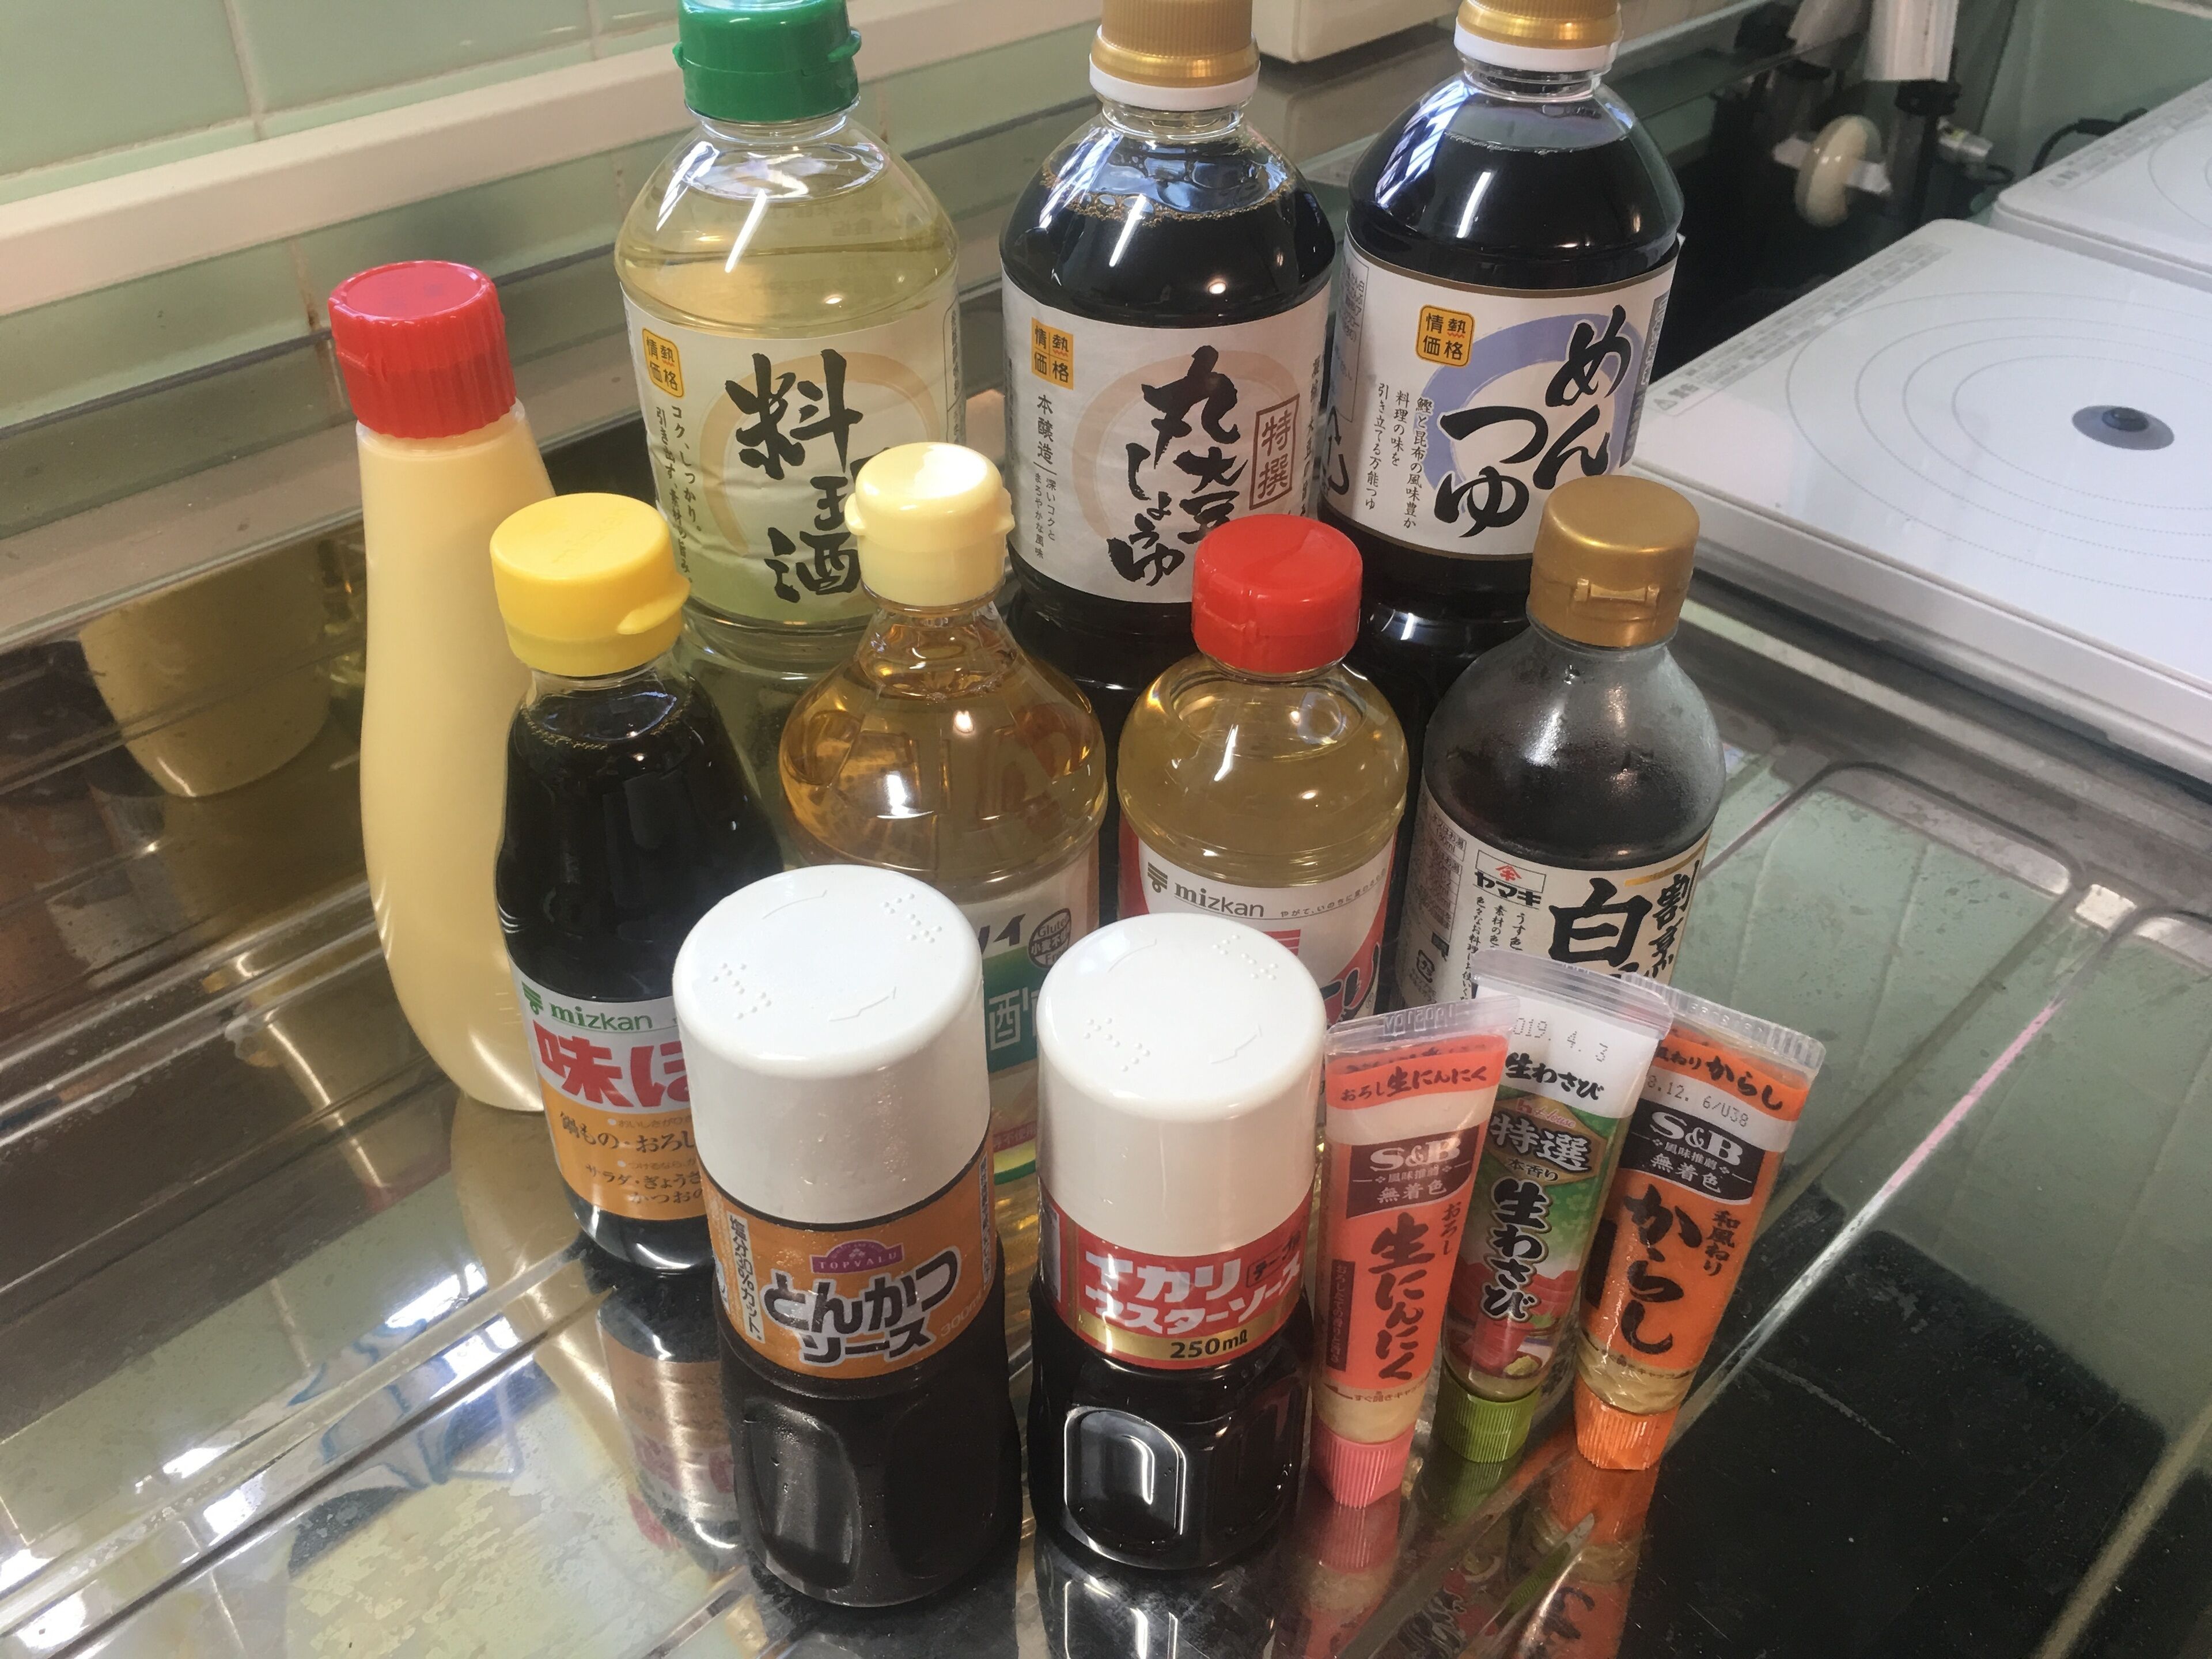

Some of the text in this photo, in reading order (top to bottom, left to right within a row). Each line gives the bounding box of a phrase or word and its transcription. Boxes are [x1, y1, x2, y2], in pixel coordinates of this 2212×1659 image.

[1034, 326, 1069, 356] 情熱
[1422, 335, 1464, 361] 価格
[1425, 312, 1467, 338] 情熱
[646, 336, 675, 368] 情熱
[649, 361, 679, 392] 価格
[1033, 351, 1070, 384] 価格
[1533, 305, 1632, 490] めん
[1037, 393, 1054, 465] 本醸造
[1141, 345, 1248, 545] 丸大豆
[1365, 382, 1389, 510] 引き立てる万能つゆ
[1390, 389, 1410, 467] 料理の味を
[1257, 409, 1292, 499] 特撰
[1403, 396, 1433, 529] 鰹と昆布の風味豊か
[1434, 406, 1549, 538] つゆ
[1035, 472, 1044, 559] まろやかな風味
[1046, 478, 1056, 541] 深いコクと
[1107, 442, 1185, 586] しょうゆ
[1175, 882, 1265, 918] mizkan
[1474, 870, 1543, 907] ヤマキ
[548, 1001, 653, 1032] mizkan
[1505, 1052, 1605, 1101] 生わさび
[1595, 1043, 1609, 1063] 3
[1340, 1065, 1487, 1101] おろし生にんにく
[1534, 1105, 1577, 1128] House
[1702, 1095, 1749, 1128] 6/U38
[1369, 1137, 1461, 1172] S&B
[1489, 1111, 1592, 1172] 特選
[1649, 1111, 1744, 1166] S&B
[1377, 1179, 1447, 1203] 無着色
[1507, 1157, 1559, 1181] 本香り
[1650, 1152, 1722, 1194] 無着色
[1441, 1202, 1462, 1256] おろし
[1485, 1177, 1550, 1322] 生わさび
[1702, 1209, 1742, 1277] 和風ねり
[819, 1252, 897, 1270] TOPVALU
[1620, 1183, 1703, 1355] からし
[763, 1249, 959, 1334] とんかつ
[1368, 1212, 1435, 1381] 生にんにく
[803, 1316, 931, 1363] ソース
